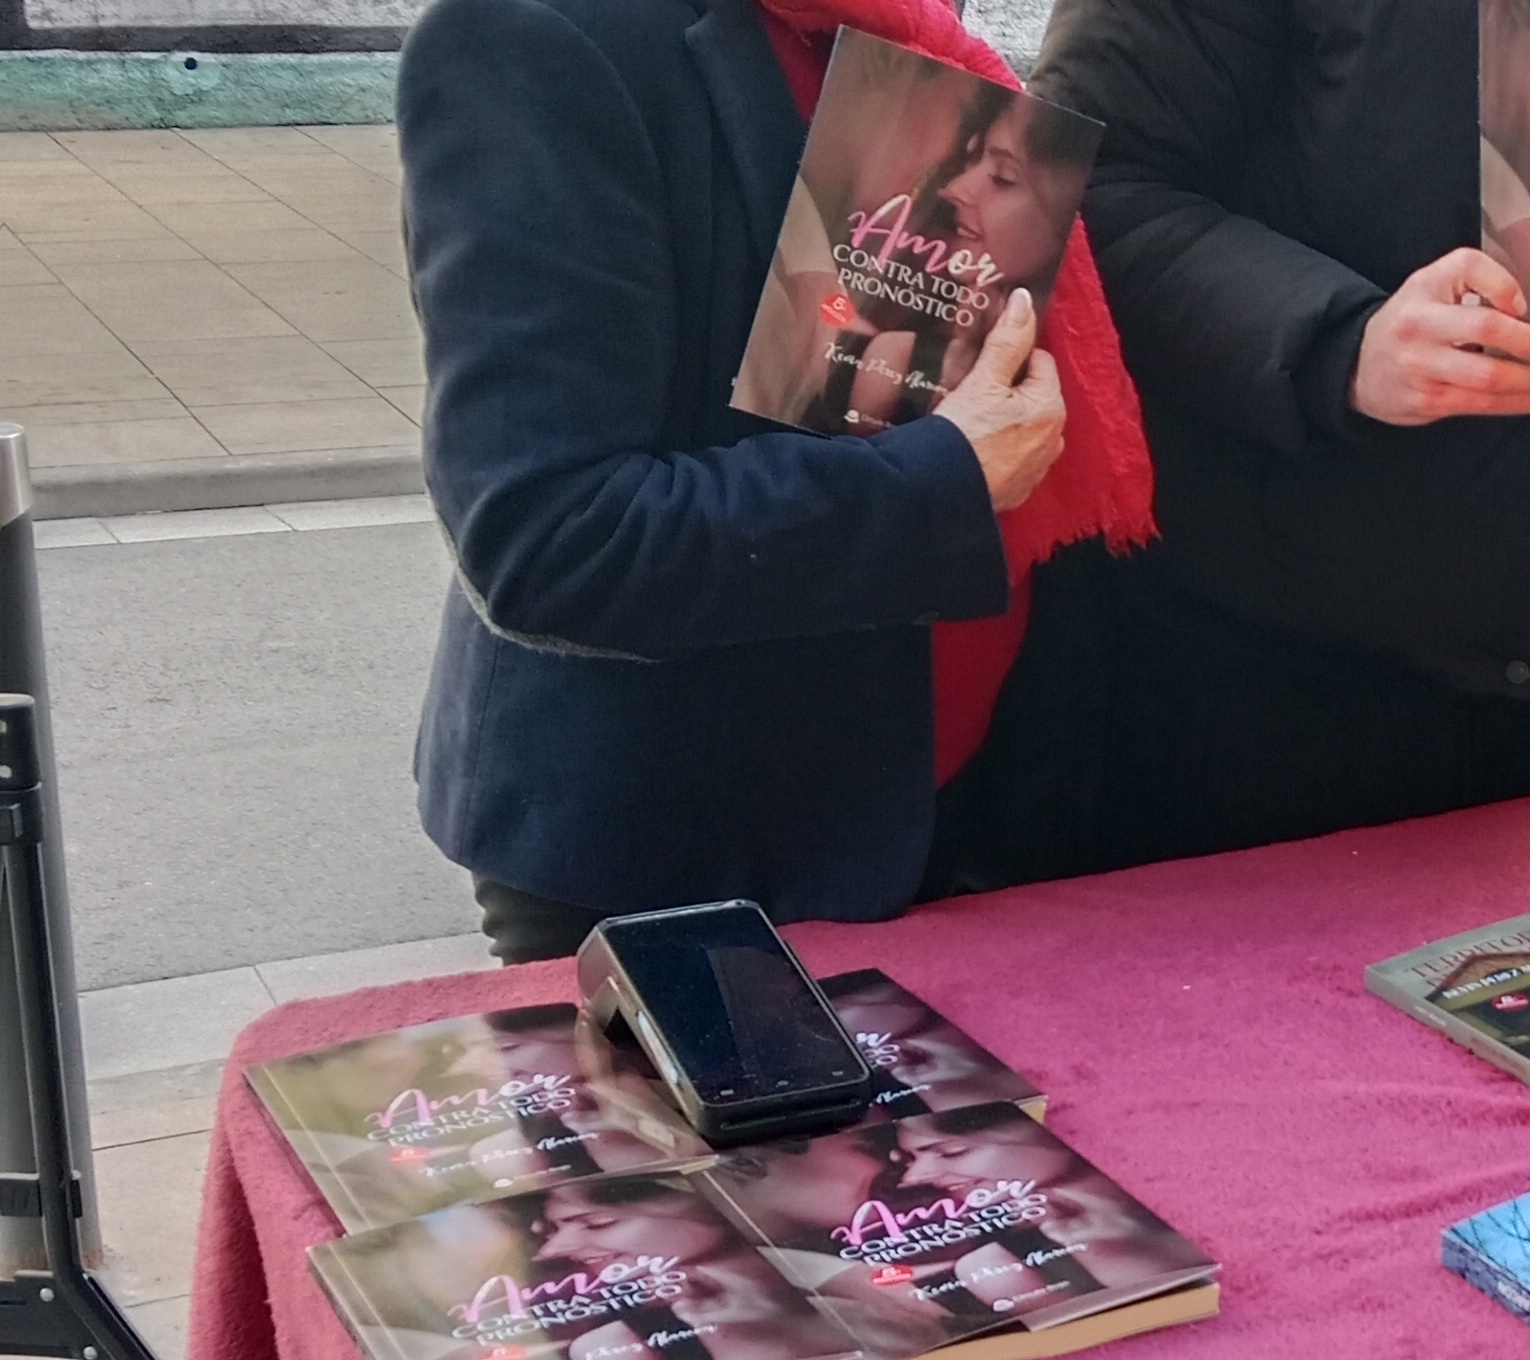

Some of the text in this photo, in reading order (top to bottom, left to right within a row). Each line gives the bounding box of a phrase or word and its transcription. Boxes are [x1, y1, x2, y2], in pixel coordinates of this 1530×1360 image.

[848, 194, 1005, 286] Amor
[832, 244, 990, 309] CONTRA TODO
[837, 267, 975, 327] PRONÓSTICO
[364, 1073, 571, 1129] Amor
[830, 1179, 1037, 1246] Amor
[839, 1193, 1048, 1261] CONTRA TODO
[447, 1255, 680, 1324] Amor
[451, 1270, 687, 1339] CONTRA TODO
